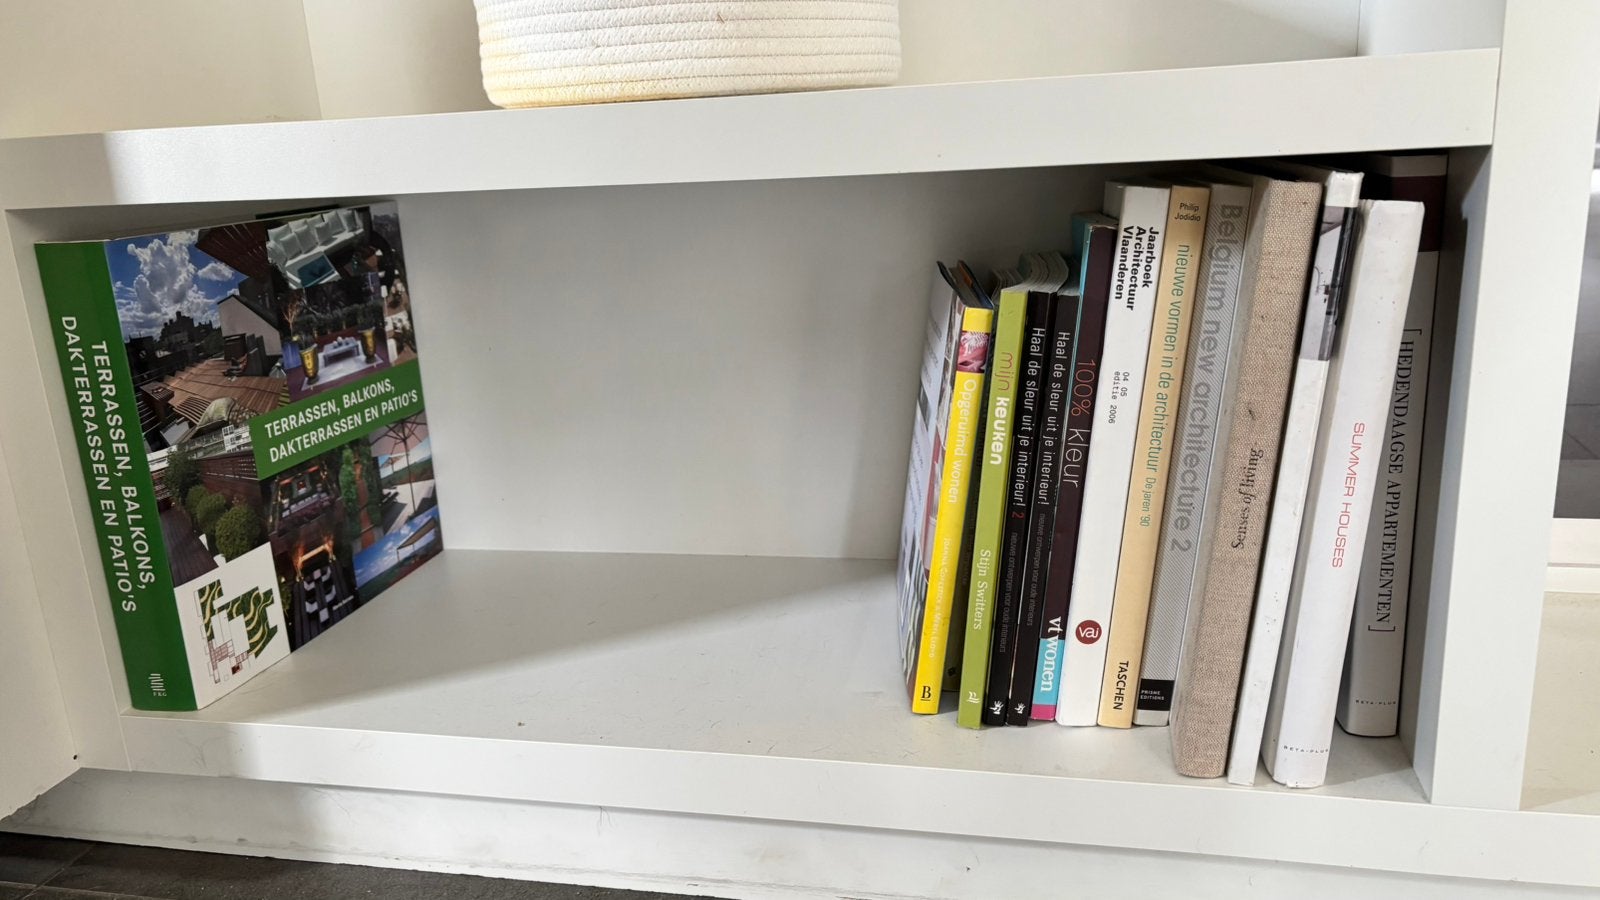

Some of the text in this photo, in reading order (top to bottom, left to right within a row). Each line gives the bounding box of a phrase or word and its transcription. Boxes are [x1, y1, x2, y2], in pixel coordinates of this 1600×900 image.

[1174, 213, 1201, 222] Jodidio
[1179, 202, 1199, 213] Philip
[1115, 226, 1134, 300] Vlaanderen
[1126, 226, 1146, 311] Architectuur
[1142, 227, 1159, 288] Jaarboek
[994, 351, 1014, 391] mijn
[1027, 361, 1041, 376] de
[1030, 328, 1046, 357] Haal
[1146, 244, 1192, 472] nieuwe vormen in de architectuur
[264, 378, 395, 439] TERRASSEN, BALKONS,
[1024, 380, 1040, 411] sleur
[1108, 371, 1120, 424] editie 2006
[1120, 372, 1130, 396] 04 05
[1170, 205, 1242, 552] Belgium new architecture 2
[269, 390, 418, 463] DAKTERRASSEN EN PATIO'S
[949, 380, 976, 504] Opgeruimd wonen
[990, 397, 1010, 465] keuken
[1018, 435, 1031, 447] je
[1021, 415, 1035, 432] uit
[1038, 331, 1070, 505] Haal de sleur uit je interieur!
[1063, 360, 1095, 488] 100% kleur
[61, 316, 137, 613] DAKTERRASSEN EN PATIO'S
[91, 341, 156, 590] TERRASSEN, BALKONS,
[1013, 451, 1031, 507] interieur!
[1140, 477, 1156, 527] De jaren '90
[1231, 449, 1264, 550] Senses of living
[1331, 423, 1365, 568] SUMMER HOUSES
[974, 550, 990, 630] Stijn Switters
[921, 685, 931, 699] B
[1113, 660, 1129, 710] TASCHEN
